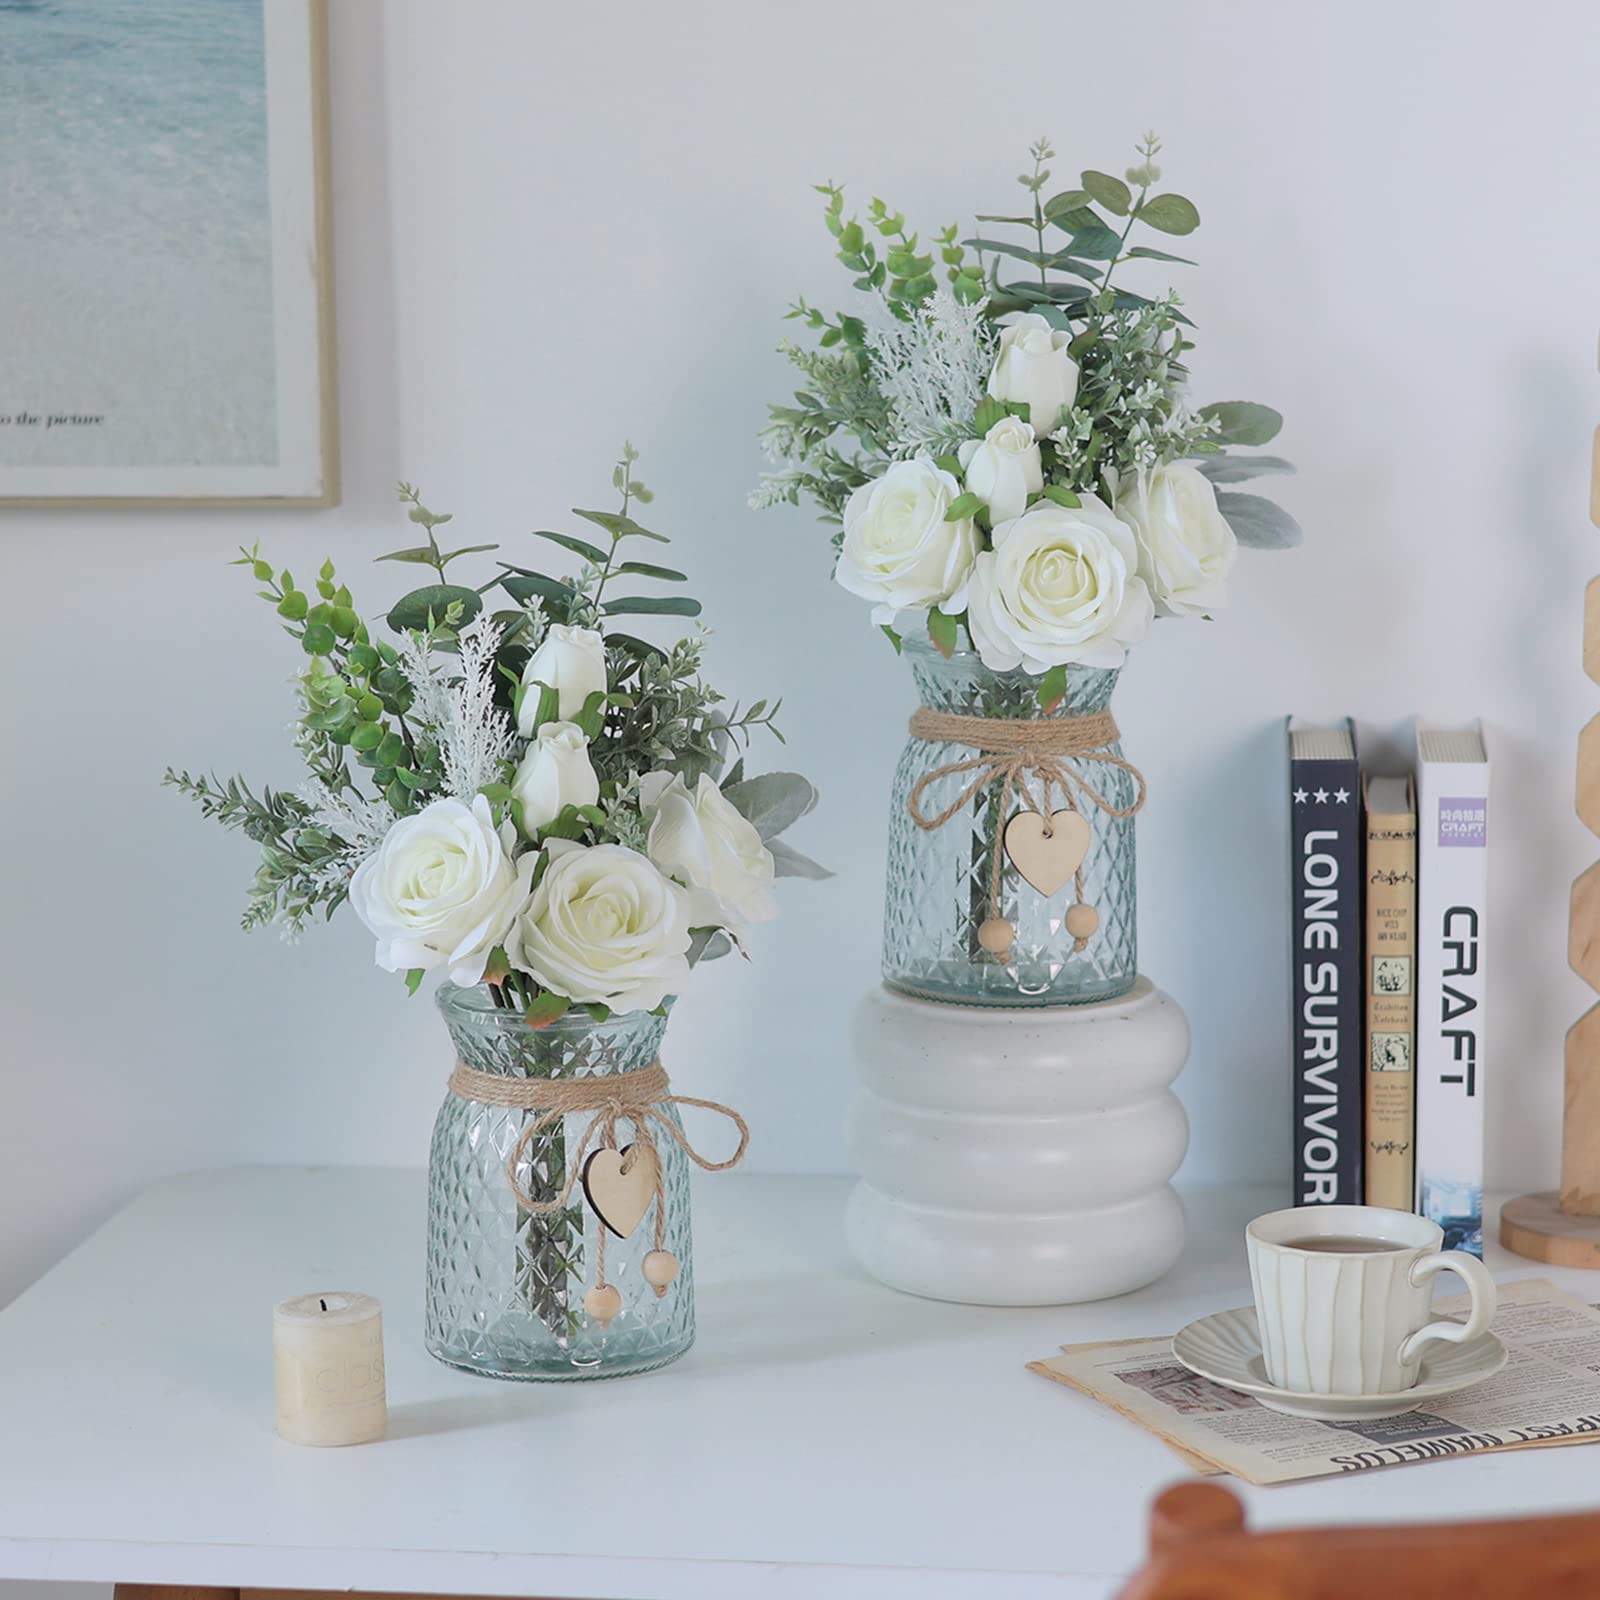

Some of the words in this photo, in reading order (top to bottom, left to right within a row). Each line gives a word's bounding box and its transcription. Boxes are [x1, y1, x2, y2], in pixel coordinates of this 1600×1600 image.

[16, 409, 42, 425] the
[46, 410, 105, 430] picture
[1441, 822, 1485, 832] CRAFT
[1303, 830, 1339, 949] LONE
[1440, 906, 1479, 1097] CRAFT
[1303, 962, 1339, 1203] SURVIVOR
